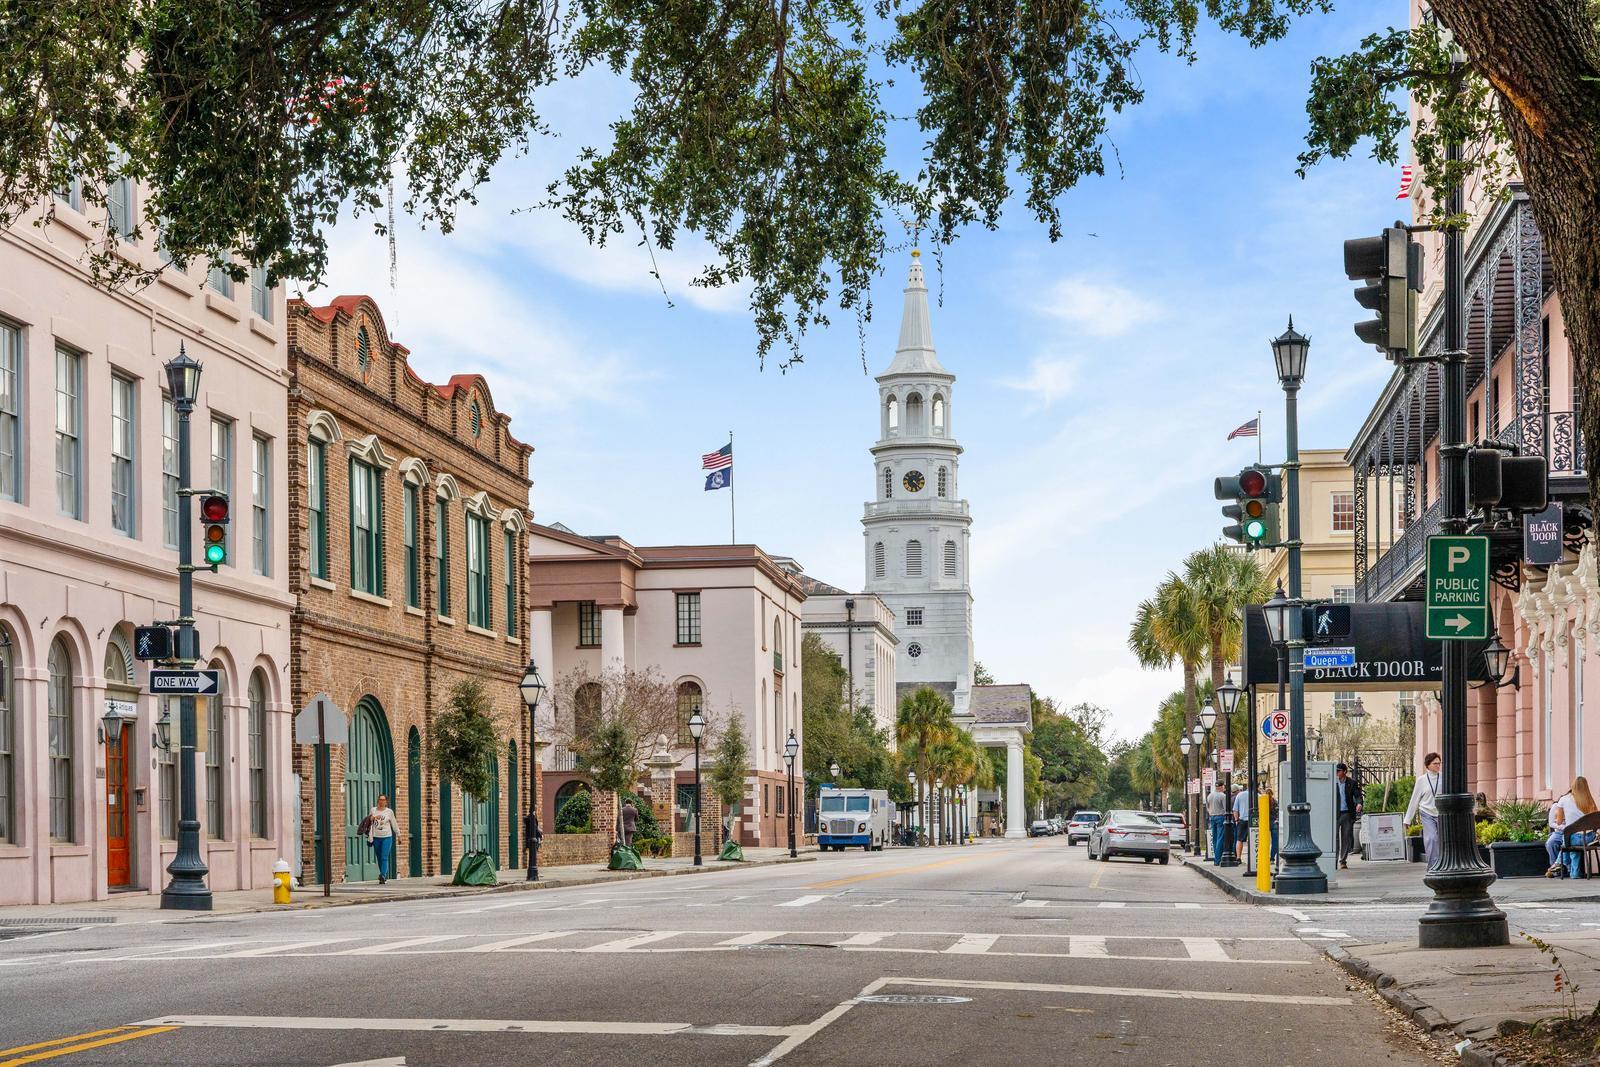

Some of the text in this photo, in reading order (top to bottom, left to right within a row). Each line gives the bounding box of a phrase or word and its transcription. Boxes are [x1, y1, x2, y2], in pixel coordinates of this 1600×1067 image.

[1529, 523, 1559, 532] BLACK
[1531, 532, 1557, 541] DOOR
[1448, 546, 1470, 572] P
[1435, 578, 1480, 590] PUBLIC
[1435, 592, 1480, 602] PARKING
[1311, 654, 1348, 666] Queen St
[1373, 660, 1425, 677] DOOR
[156, 677, 199, 687] ONE WAY
